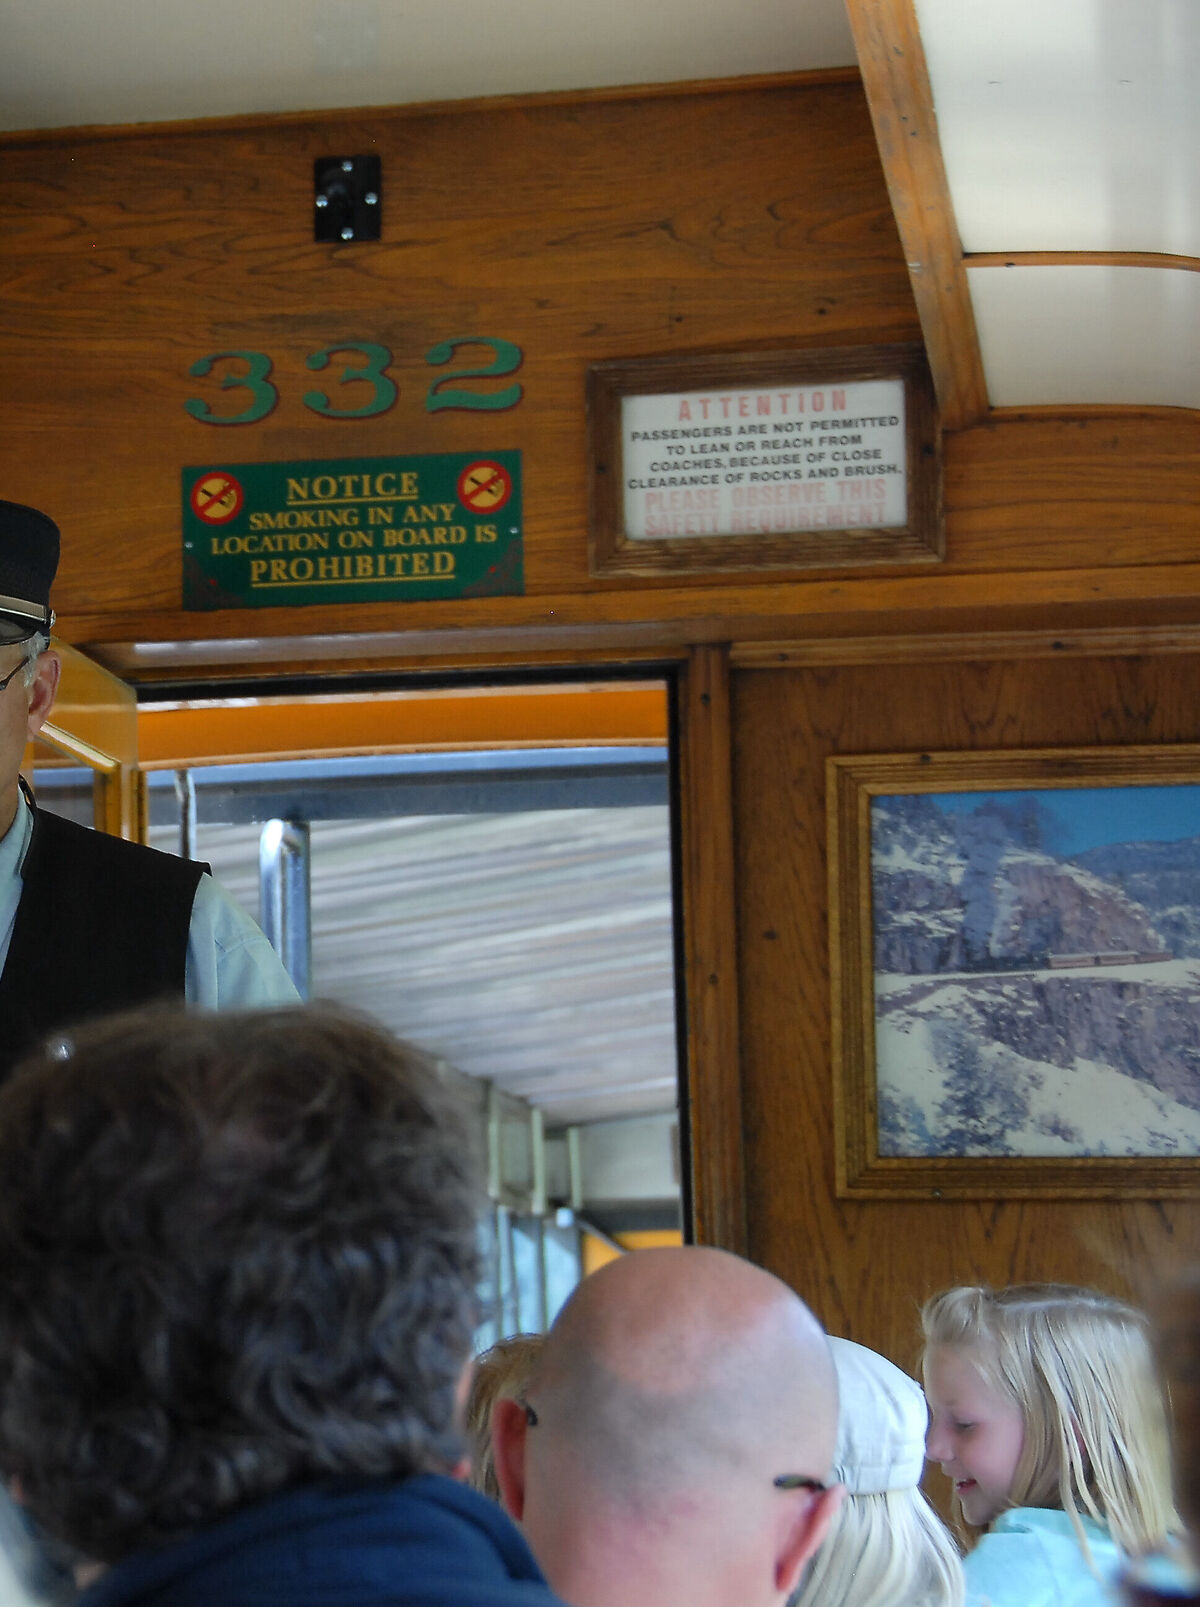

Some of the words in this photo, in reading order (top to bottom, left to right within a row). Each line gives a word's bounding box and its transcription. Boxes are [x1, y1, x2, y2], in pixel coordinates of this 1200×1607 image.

[183, 336, 524, 427] 332
[678, 389, 848, 421] ATTENTION
[631, 425, 733, 442] PASSENGERS
[737, 423, 768, 436] ARE
[773, 421, 803, 434] NOT
[810, 416, 899, 431] PERMITTED
[666, 445, 685, 456] TO
[690, 442, 730, 455] LEAN
[735, 440, 756, 451] OR
[761, 437, 814, 450] REACH
[818, 435, 863, 447] FROM
[650, 457, 727, 473] COACHES,
[729, 453, 801, 468] BECAUSE
[807, 452, 826, 464] OF
[831, 449, 882, 462] CLOSE
[286, 472, 419, 501] NOTICE
[627, 474, 720, 490] CLEARANCE
[725, 473, 744, 484] OF
[750, 469, 801, 482] ROCKS
[807, 467, 839, 479] AND
[844, 463, 902, 477] BRUSH.
[645, 488, 720, 512] PLEASE
[731, 482, 826, 507] OBSERVE
[837, 479, 886, 501] THIS
[249, 508, 359, 530] SMOKING
[368, 507, 393, 525] IN
[403, 504, 456, 523] ANY
[645, 511, 720, 537] SAFETY
[731, 502, 886, 534] REQUIREMENT
[211, 532, 329, 555] LOCATION
[338, 530, 373, 549] ON
[383, 526, 467, 548] BOARD
[475, 524, 497, 543] IS
[251, 551, 456, 582] PROHIBITED
